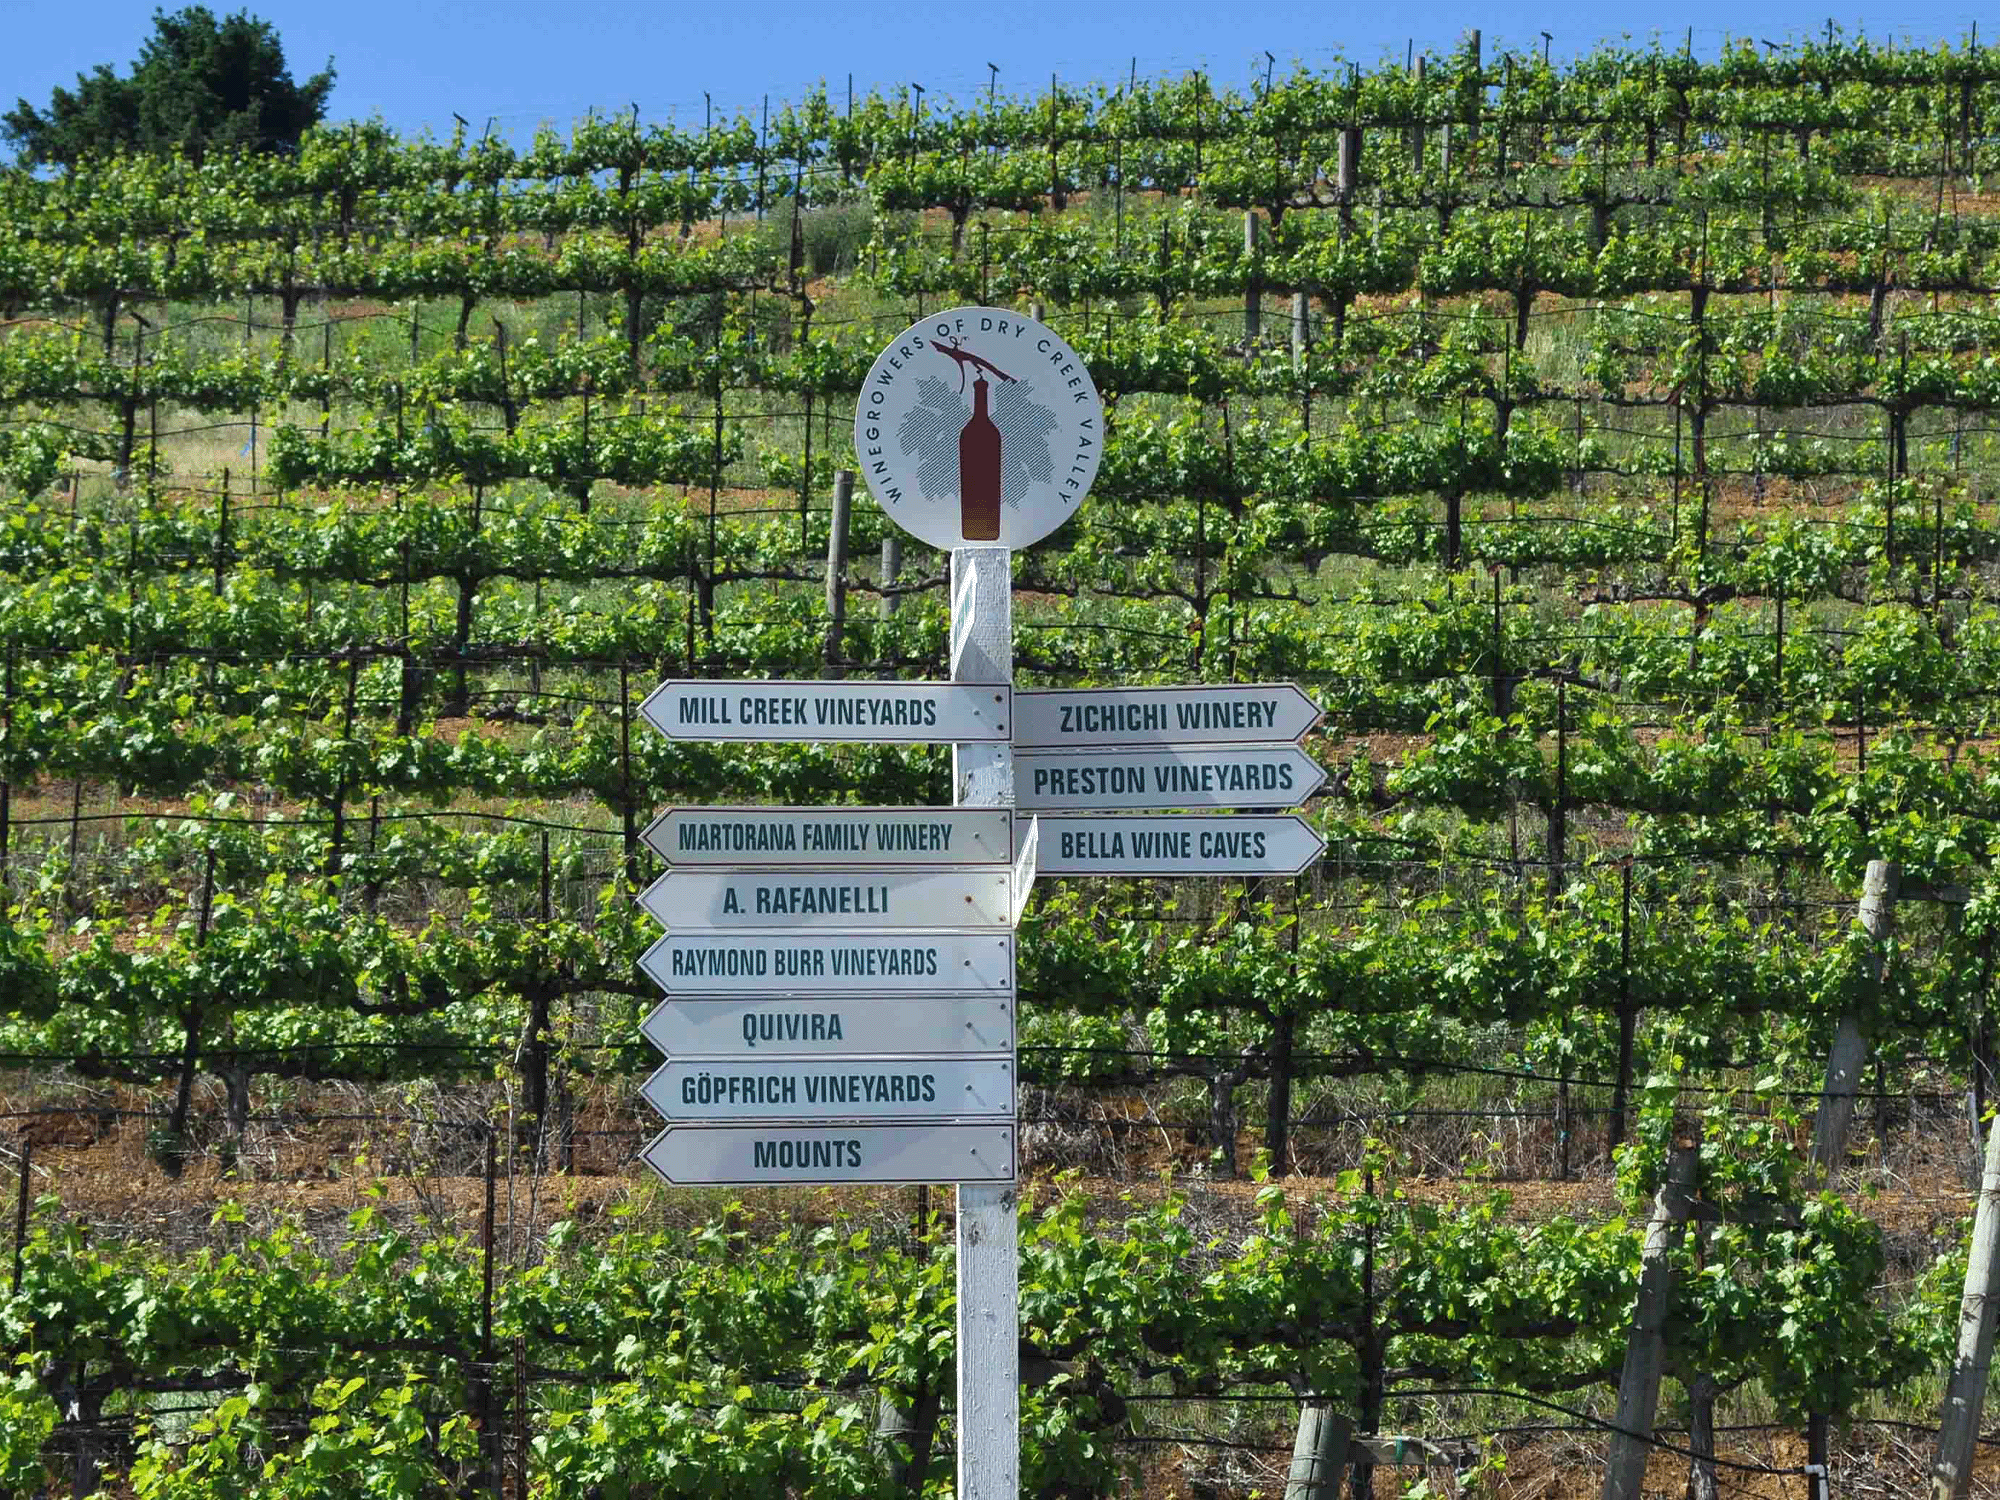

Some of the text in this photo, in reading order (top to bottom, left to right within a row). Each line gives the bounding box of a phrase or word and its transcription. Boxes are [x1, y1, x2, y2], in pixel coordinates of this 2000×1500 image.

[866, 318, 1093, 506] WINEGROWERS OF DRY CREEK VALLEY
[679, 696, 936, 727] MILL CREEK VINEYARDS
[1059, 700, 1279, 734] ZICHICHI WINERY
[1033, 763, 1293, 796] PRESTON VINEYARDS
[679, 822, 953, 852] MARTORANA FAMILY WINERY
[1061, 831, 1267, 860] BELLA WINE CAVES
[722, 886, 889, 915] A. RAFANELLI
[671, 947, 938, 977] RAYMOND BURR VINEYARDS
[742, 1012, 844, 1047] QUIVIRA
[681, 1071, 936, 1105] GÖPFRICH VINEYARDS
[753, 1138, 862, 1169] MOUNTS
